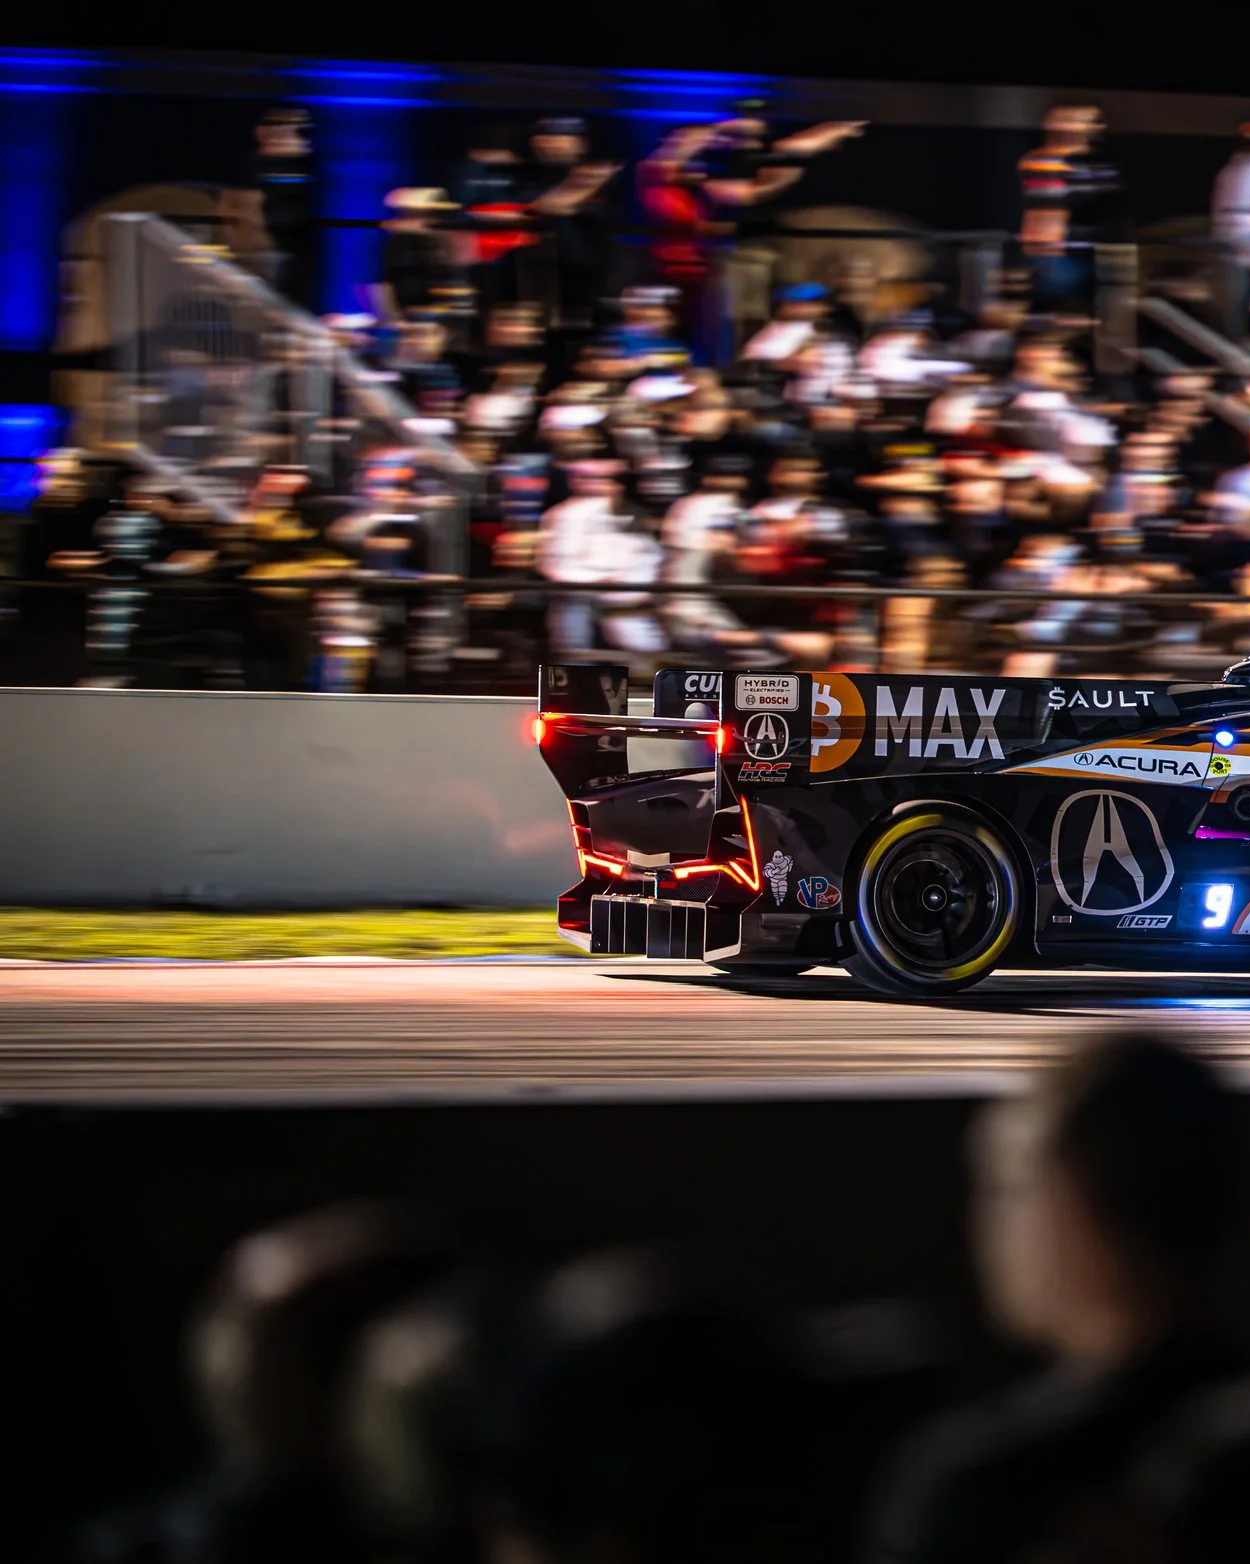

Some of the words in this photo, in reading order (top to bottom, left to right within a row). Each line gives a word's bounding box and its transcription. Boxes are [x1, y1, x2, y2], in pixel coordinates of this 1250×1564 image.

[744, 679, 788, 688] HYBRID
[759, 696, 789, 705] BOSCH
[875, 686, 1007, 760] MAX
[738, 761, 792, 779] HRC
[1094, 754, 1202, 778] ACURA
[798, 876, 828, 909] VP
[1202, 884, 1233, 928] 9
[1134, 916, 1167, 926] GTP
